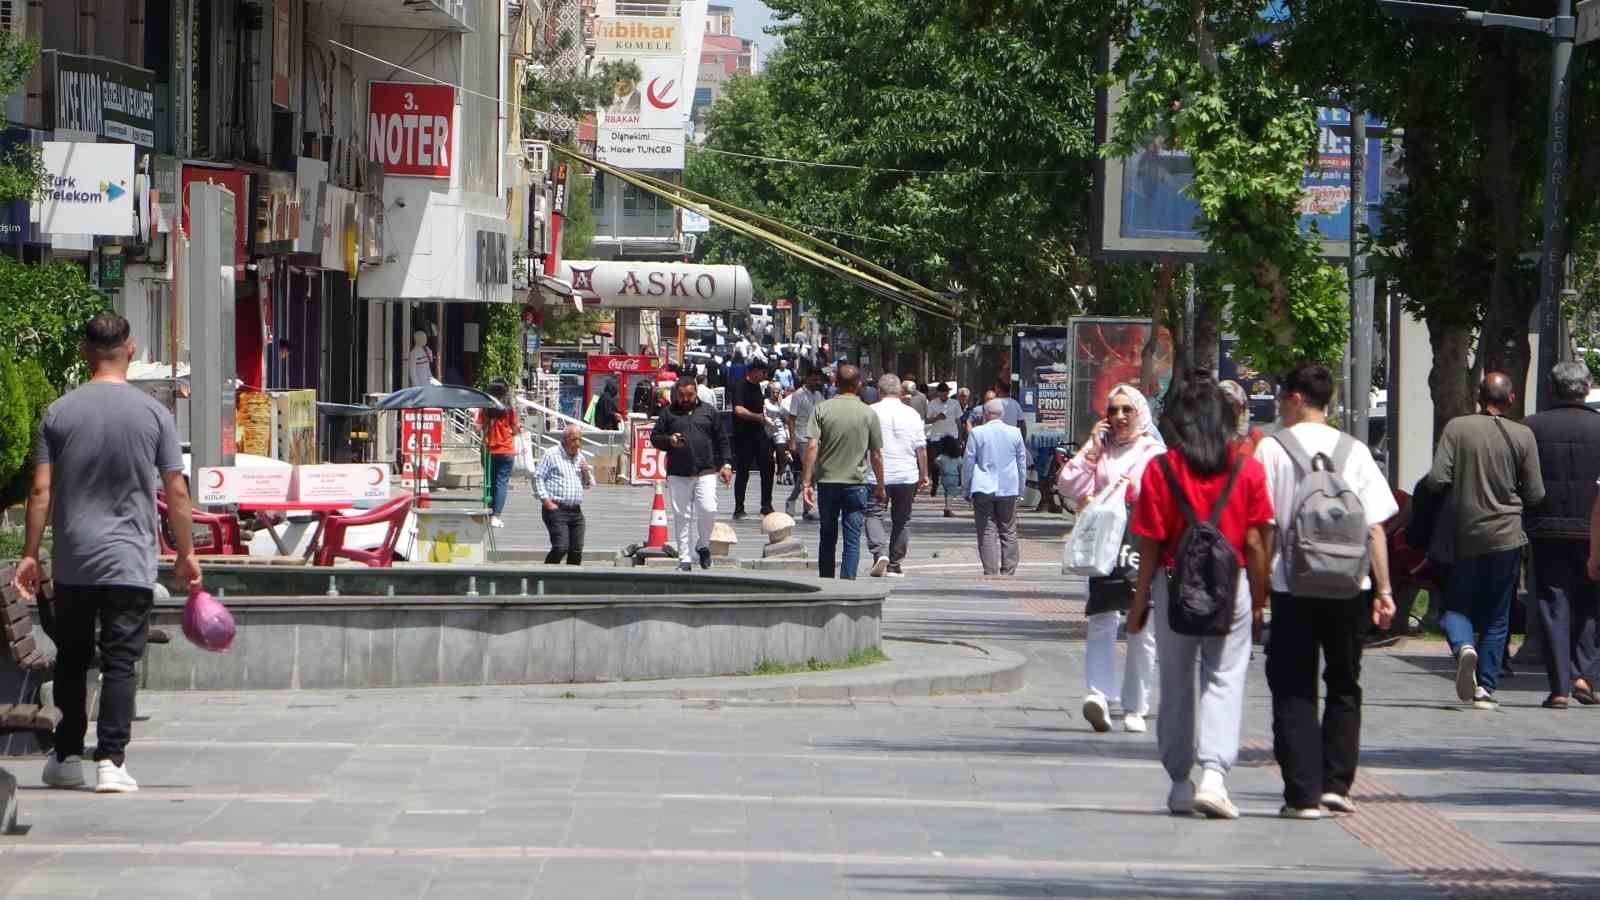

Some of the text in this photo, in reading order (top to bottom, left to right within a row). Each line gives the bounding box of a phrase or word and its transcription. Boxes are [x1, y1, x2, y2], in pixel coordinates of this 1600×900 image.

[403, 92, 420, 111] 3.
[368, 112, 449, 167] NOTER
[610, 145, 635, 153] Hacer
[47, 189, 103, 203] Telekom
[616, 270, 716, 298] ASKO
[607, 358, 641, 370] Coca-Cola
